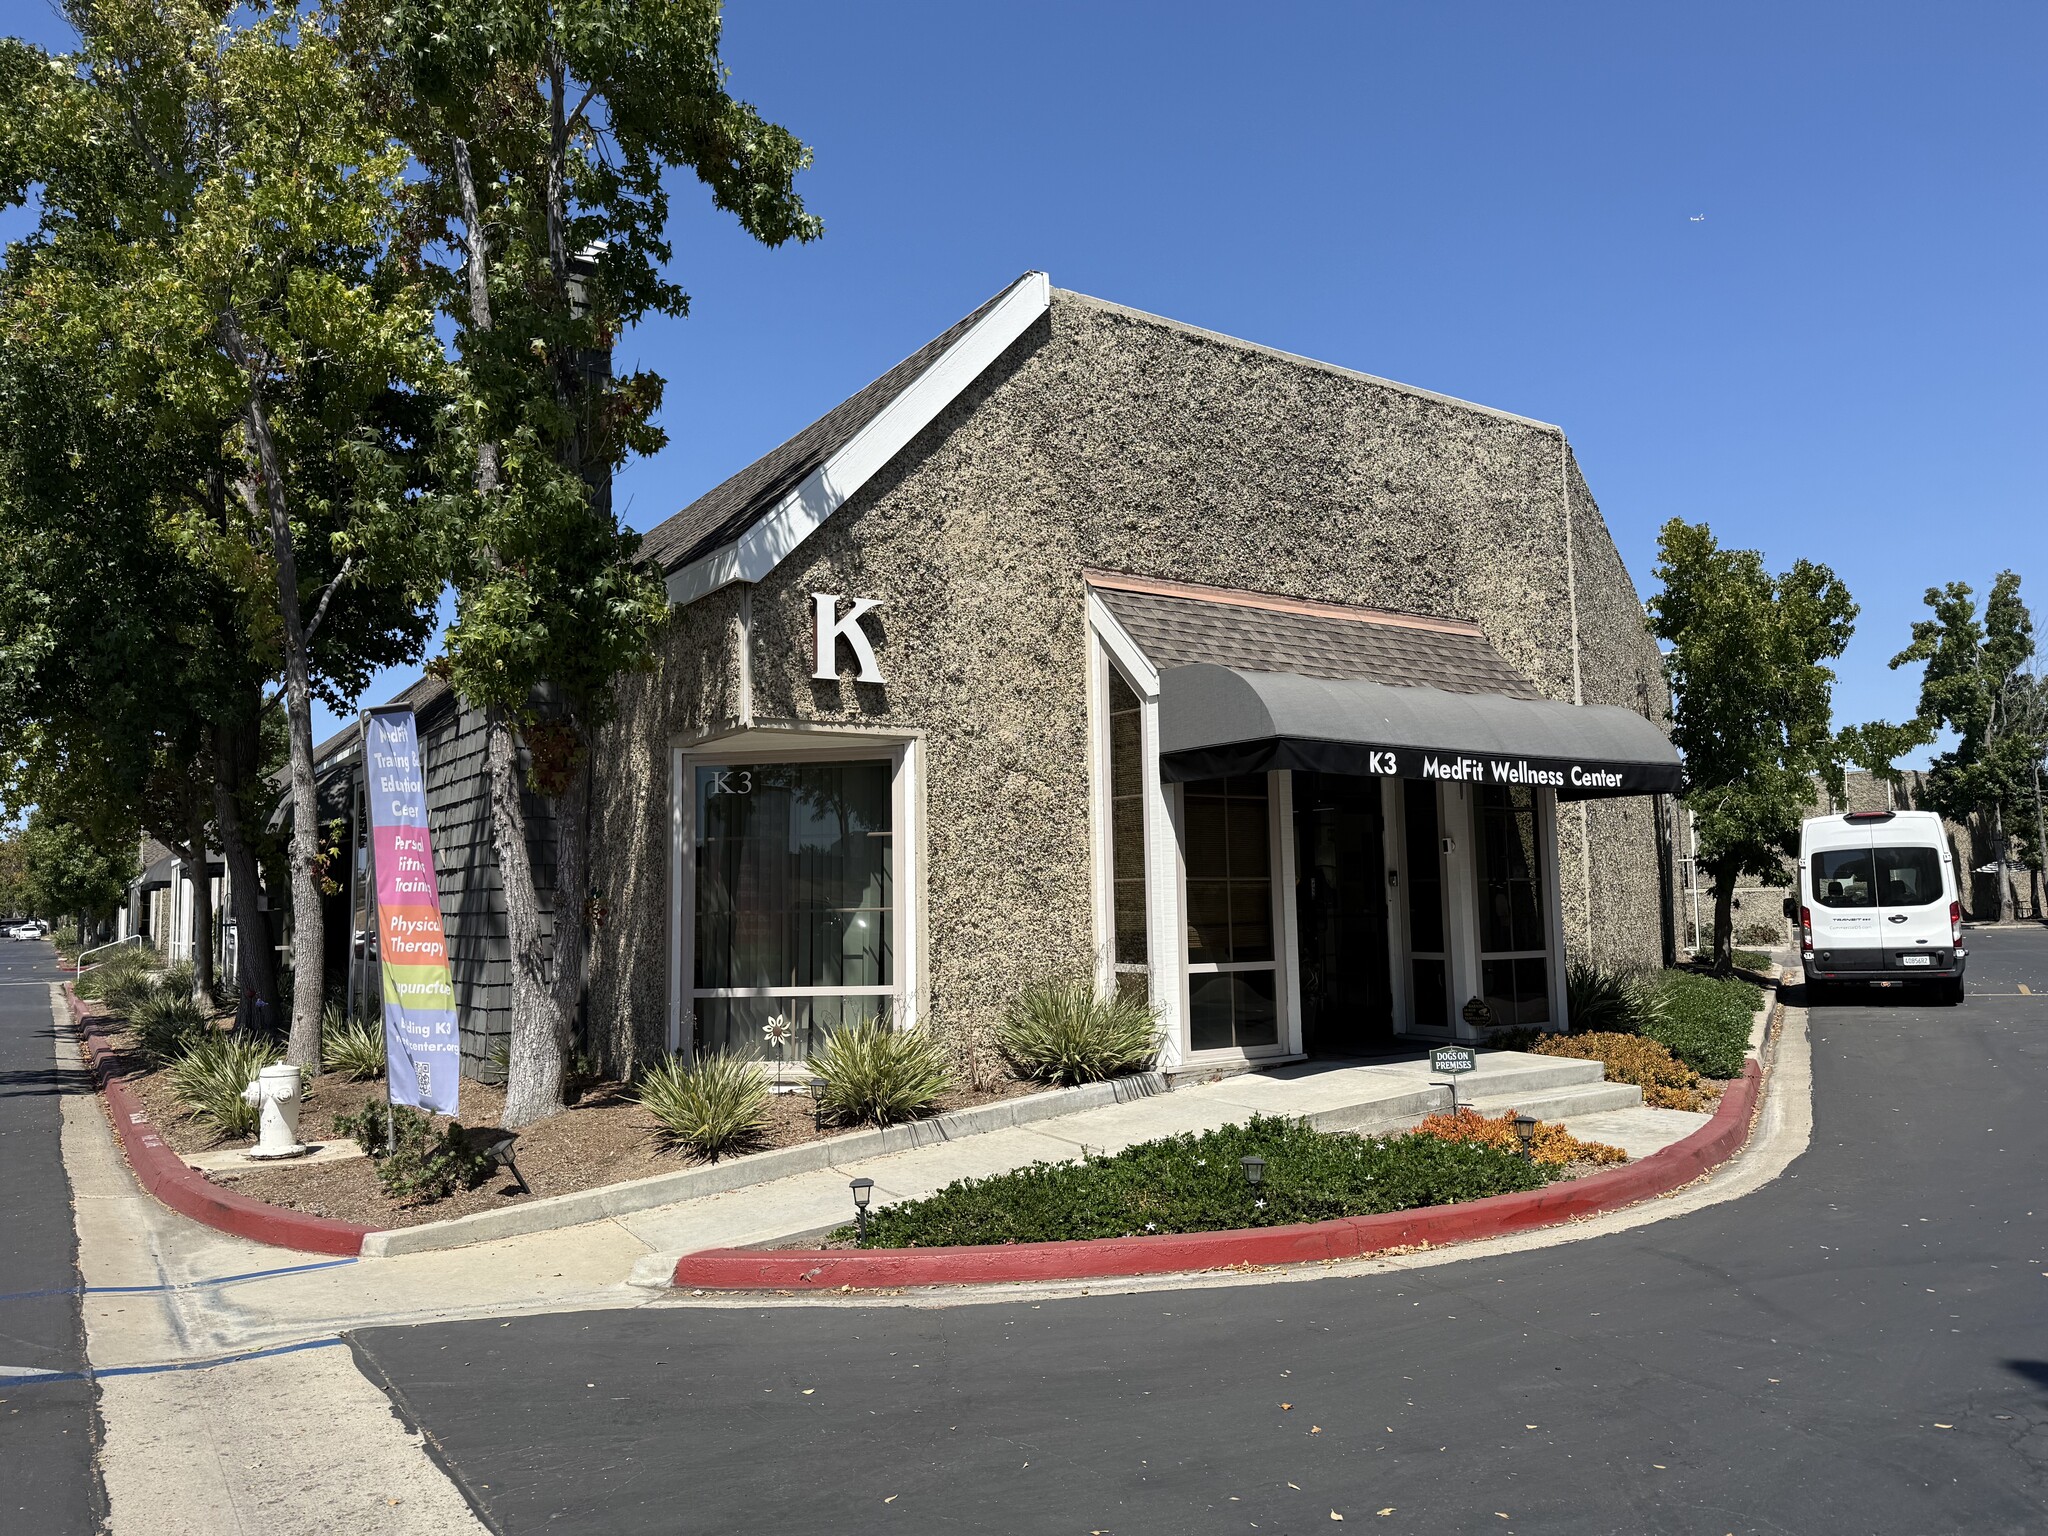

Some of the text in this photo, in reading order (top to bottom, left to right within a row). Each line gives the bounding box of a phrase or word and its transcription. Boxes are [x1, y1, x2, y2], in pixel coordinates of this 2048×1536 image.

[811, 592, 888, 683] K
[1369, 751, 1622, 787] K3 MedFit Wellness Center
[712, 771, 752, 794] K3
[391, 936, 443, 957] Therapy
[435, 1021, 451, 1035] K3
[1435, 1061, 1472, 1070] PREMISES
[1437, 1052, 1469, 1060] DOGS ON
